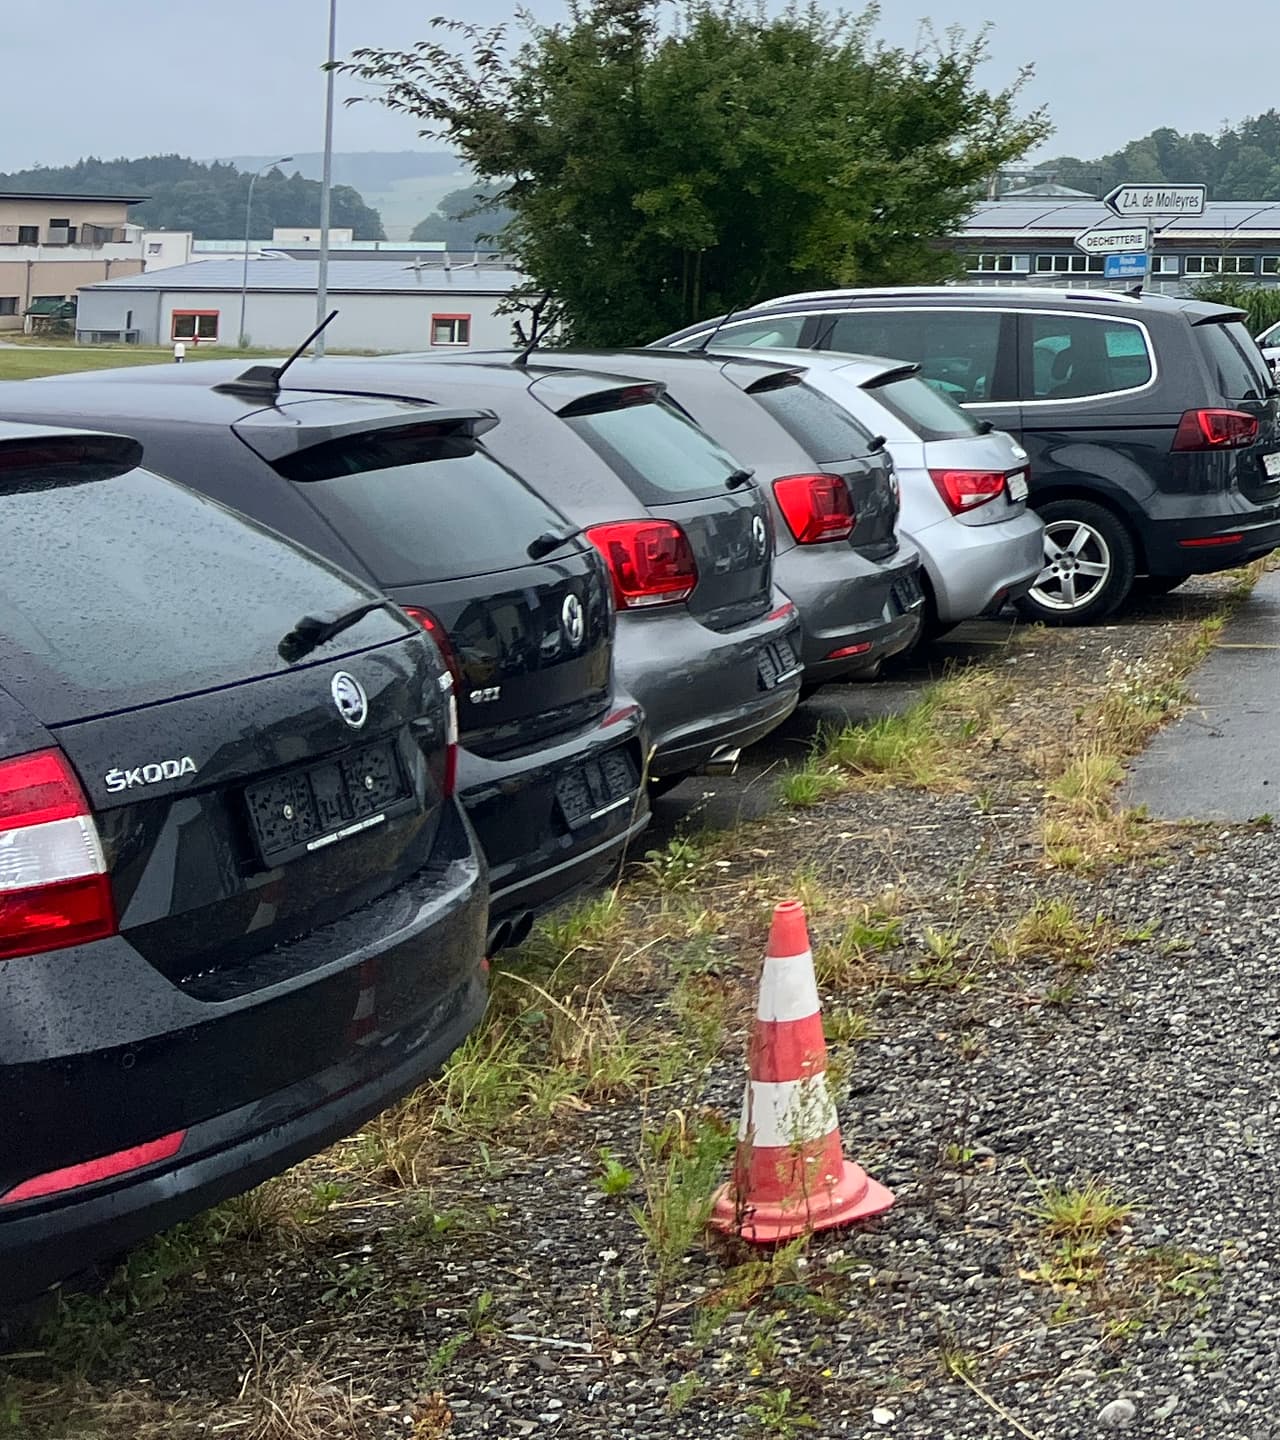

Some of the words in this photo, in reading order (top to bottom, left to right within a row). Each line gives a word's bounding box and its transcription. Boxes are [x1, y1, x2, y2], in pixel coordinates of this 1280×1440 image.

[1122, 192, 1139, 208] Z.A.
[1143, 191, 1154, 208] de
[1156, 191, 1199, 211] Molleyres
[105, 756, 199, 793] ŠKODA
